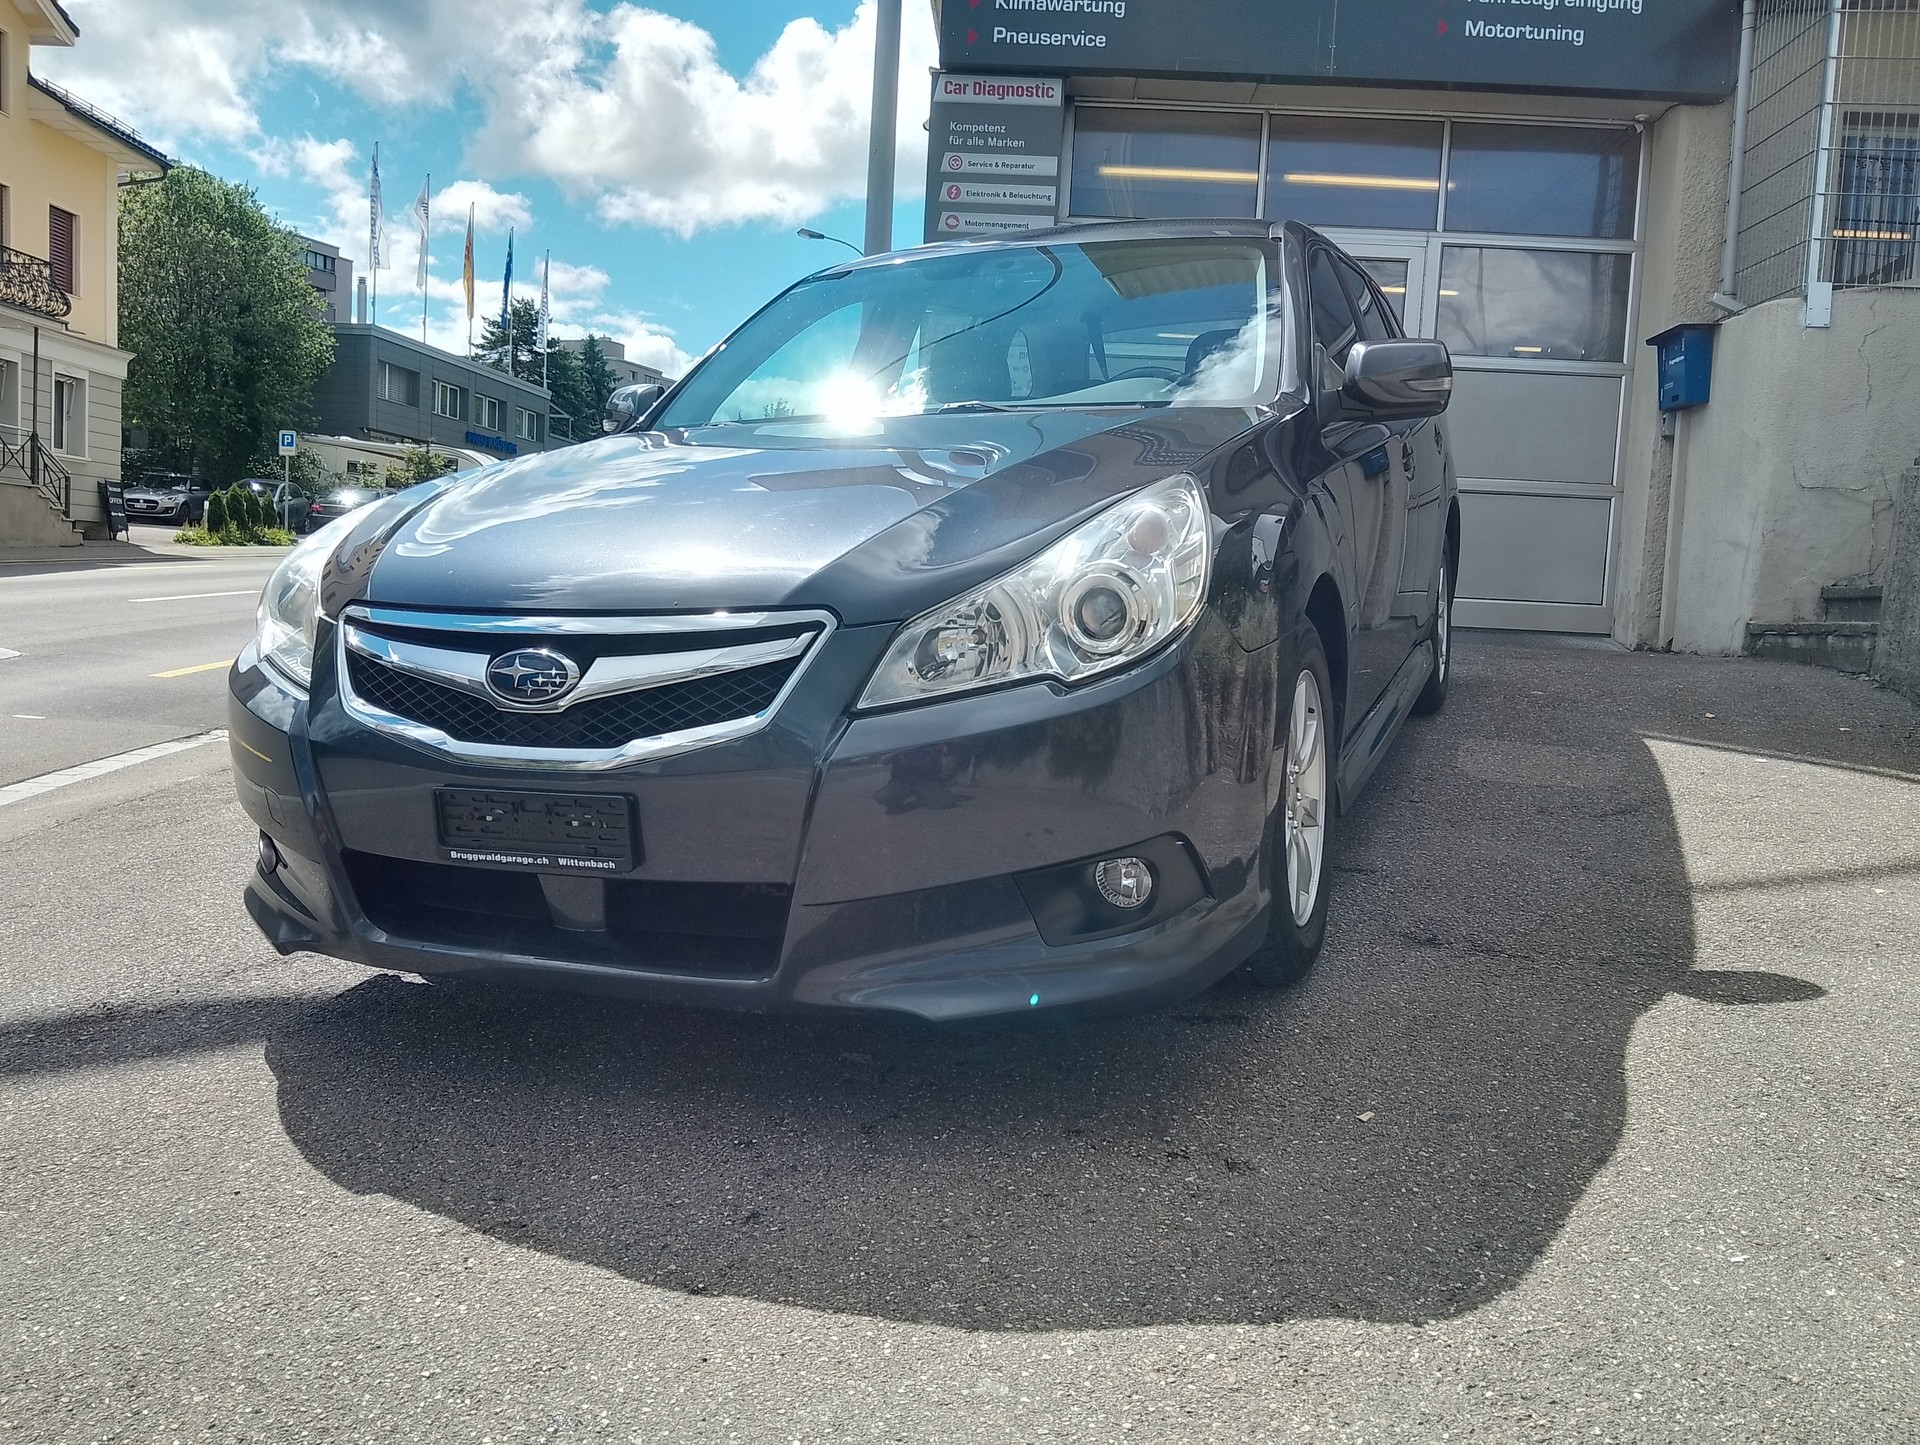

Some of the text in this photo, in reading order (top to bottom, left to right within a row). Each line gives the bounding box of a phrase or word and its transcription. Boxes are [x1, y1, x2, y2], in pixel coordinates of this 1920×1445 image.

[995, 0, 1126, 18] Klimawartung
[993, 26, 1107, 47] Pneuservice
[1464, 20, 1585, 46] Motortuning
[943, 80, 1055, 101] Car Diagnostic
[949, 121, 1006, 134] Kompetenz
[948, 135, 1025, 149] für alle Marken
[967, 160, 1036, 171] Service & Reparatur
[965, 189, 1052, 203] Elektronik & Beleuchtung
[964, 219, 1030, 231] Motormanagement
[450, 851, 616, 869] Bruggwaldgarage.ch Wittenbach
